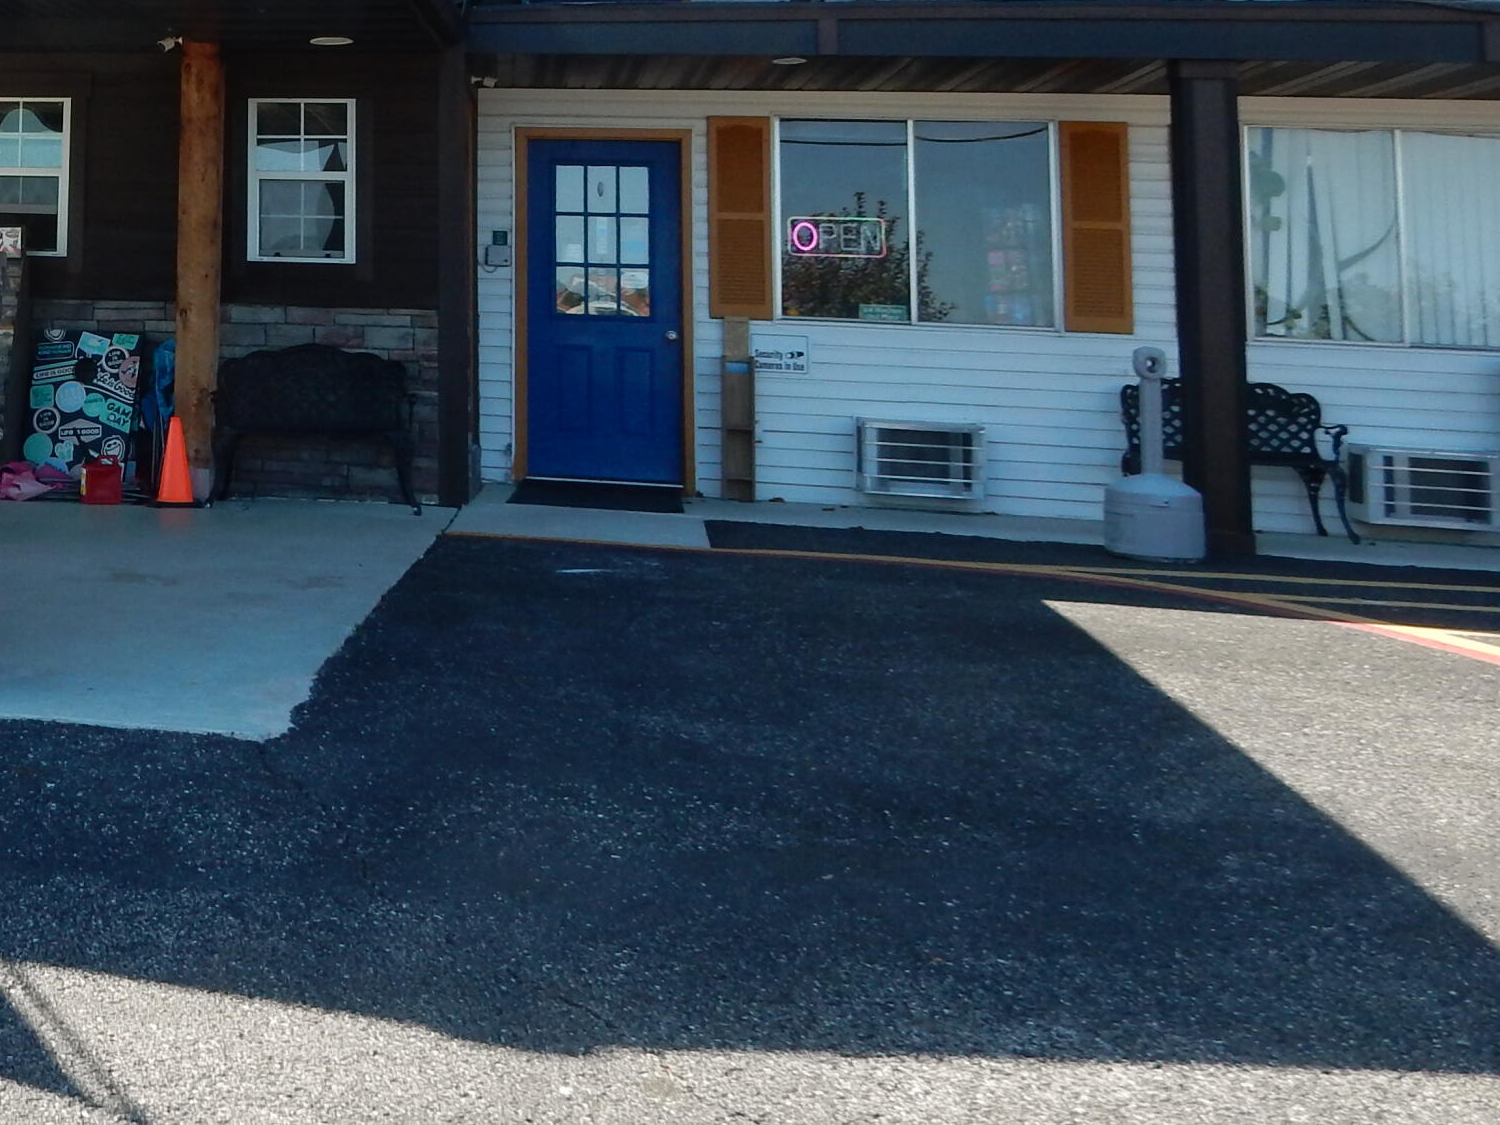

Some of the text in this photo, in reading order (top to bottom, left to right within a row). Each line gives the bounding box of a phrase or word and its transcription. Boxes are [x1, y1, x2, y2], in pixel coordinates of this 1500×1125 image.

[793, 221, 880, 251] OPEN
[755, 349, 783, 360] Security
[755, 360, 783, 369] Cameras
[793, 362, 805, 371] Use
